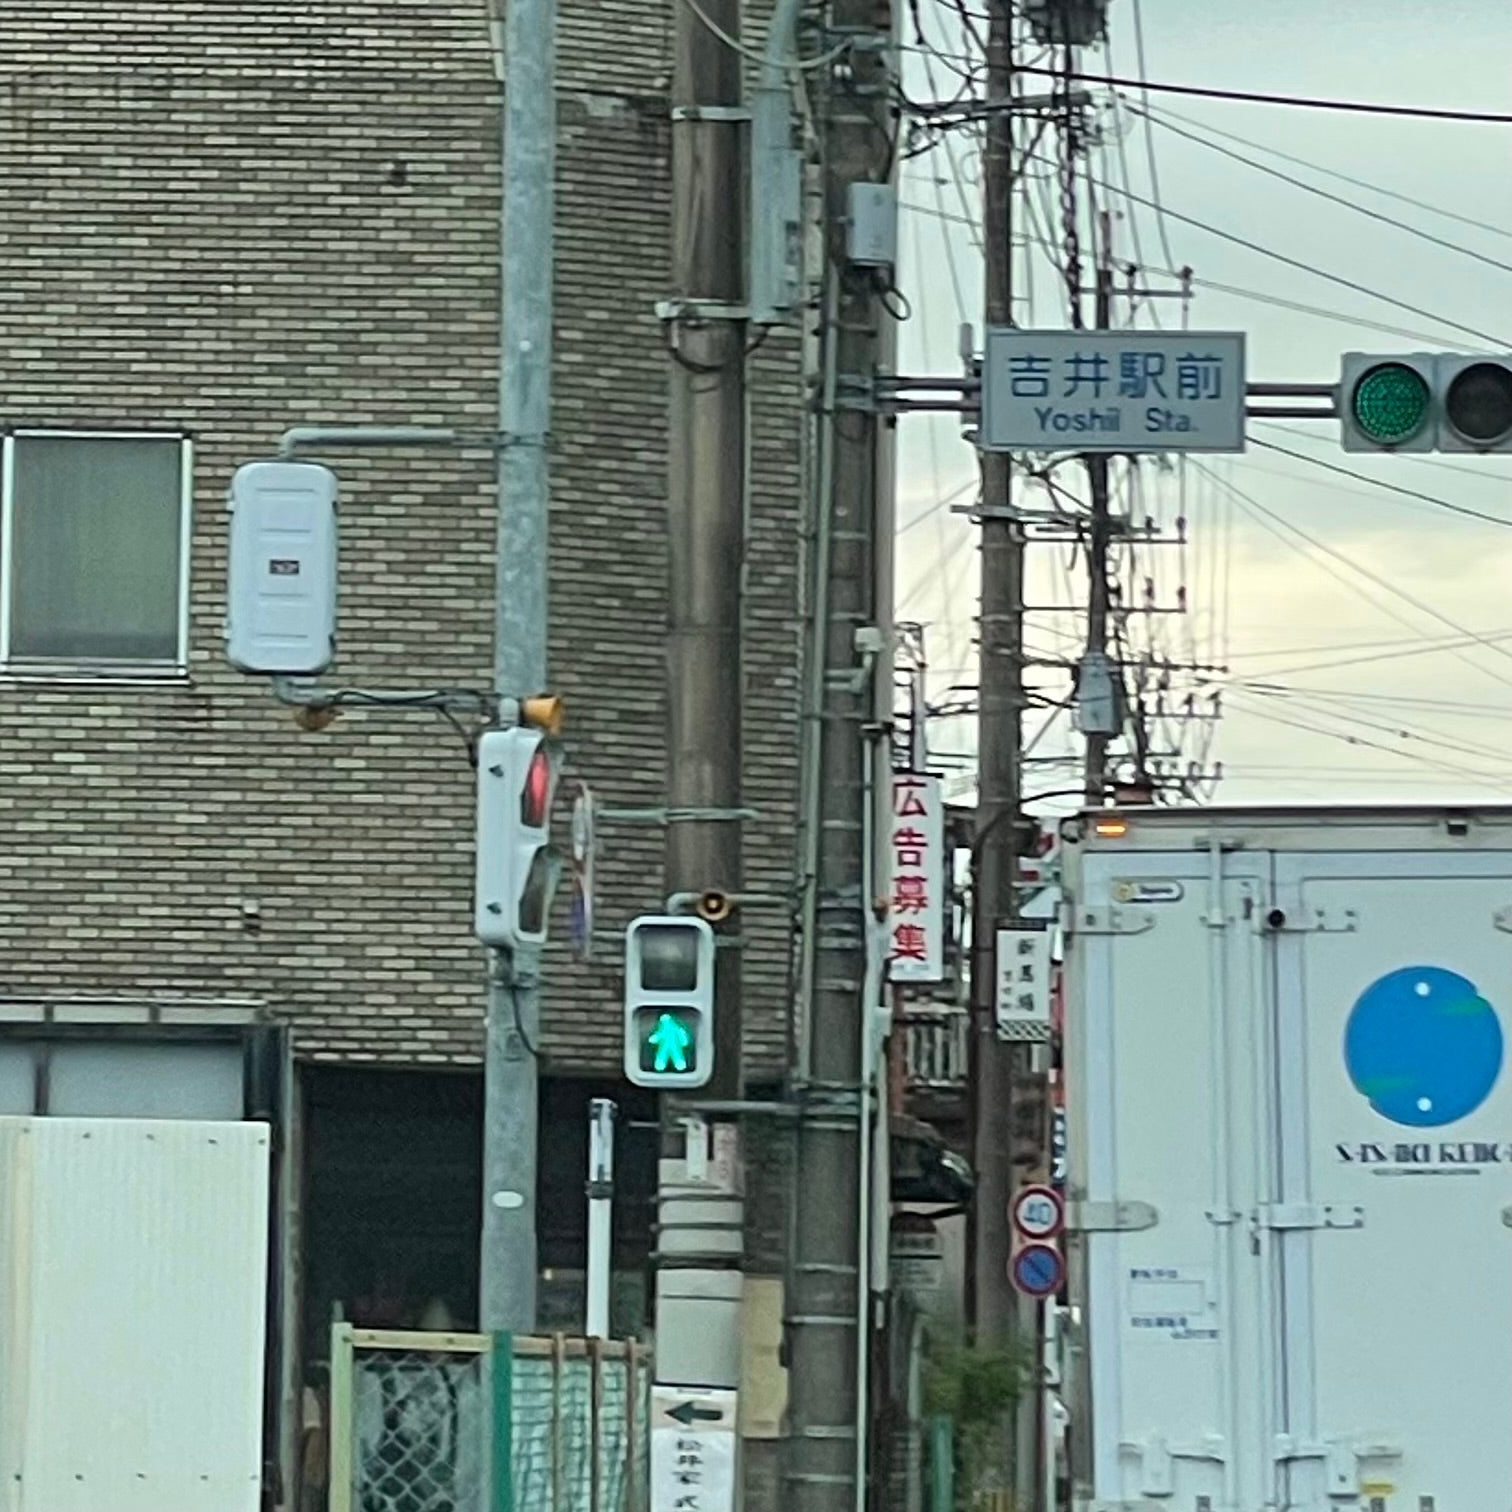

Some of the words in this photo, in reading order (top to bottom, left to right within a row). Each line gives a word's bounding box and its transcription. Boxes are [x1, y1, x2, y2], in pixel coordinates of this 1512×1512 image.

[1007, 351, 1224, 400] 吉井駅前
[1145, 407, 1200, 433] Sta.
[891, 778, 928, 961] 広告募集
